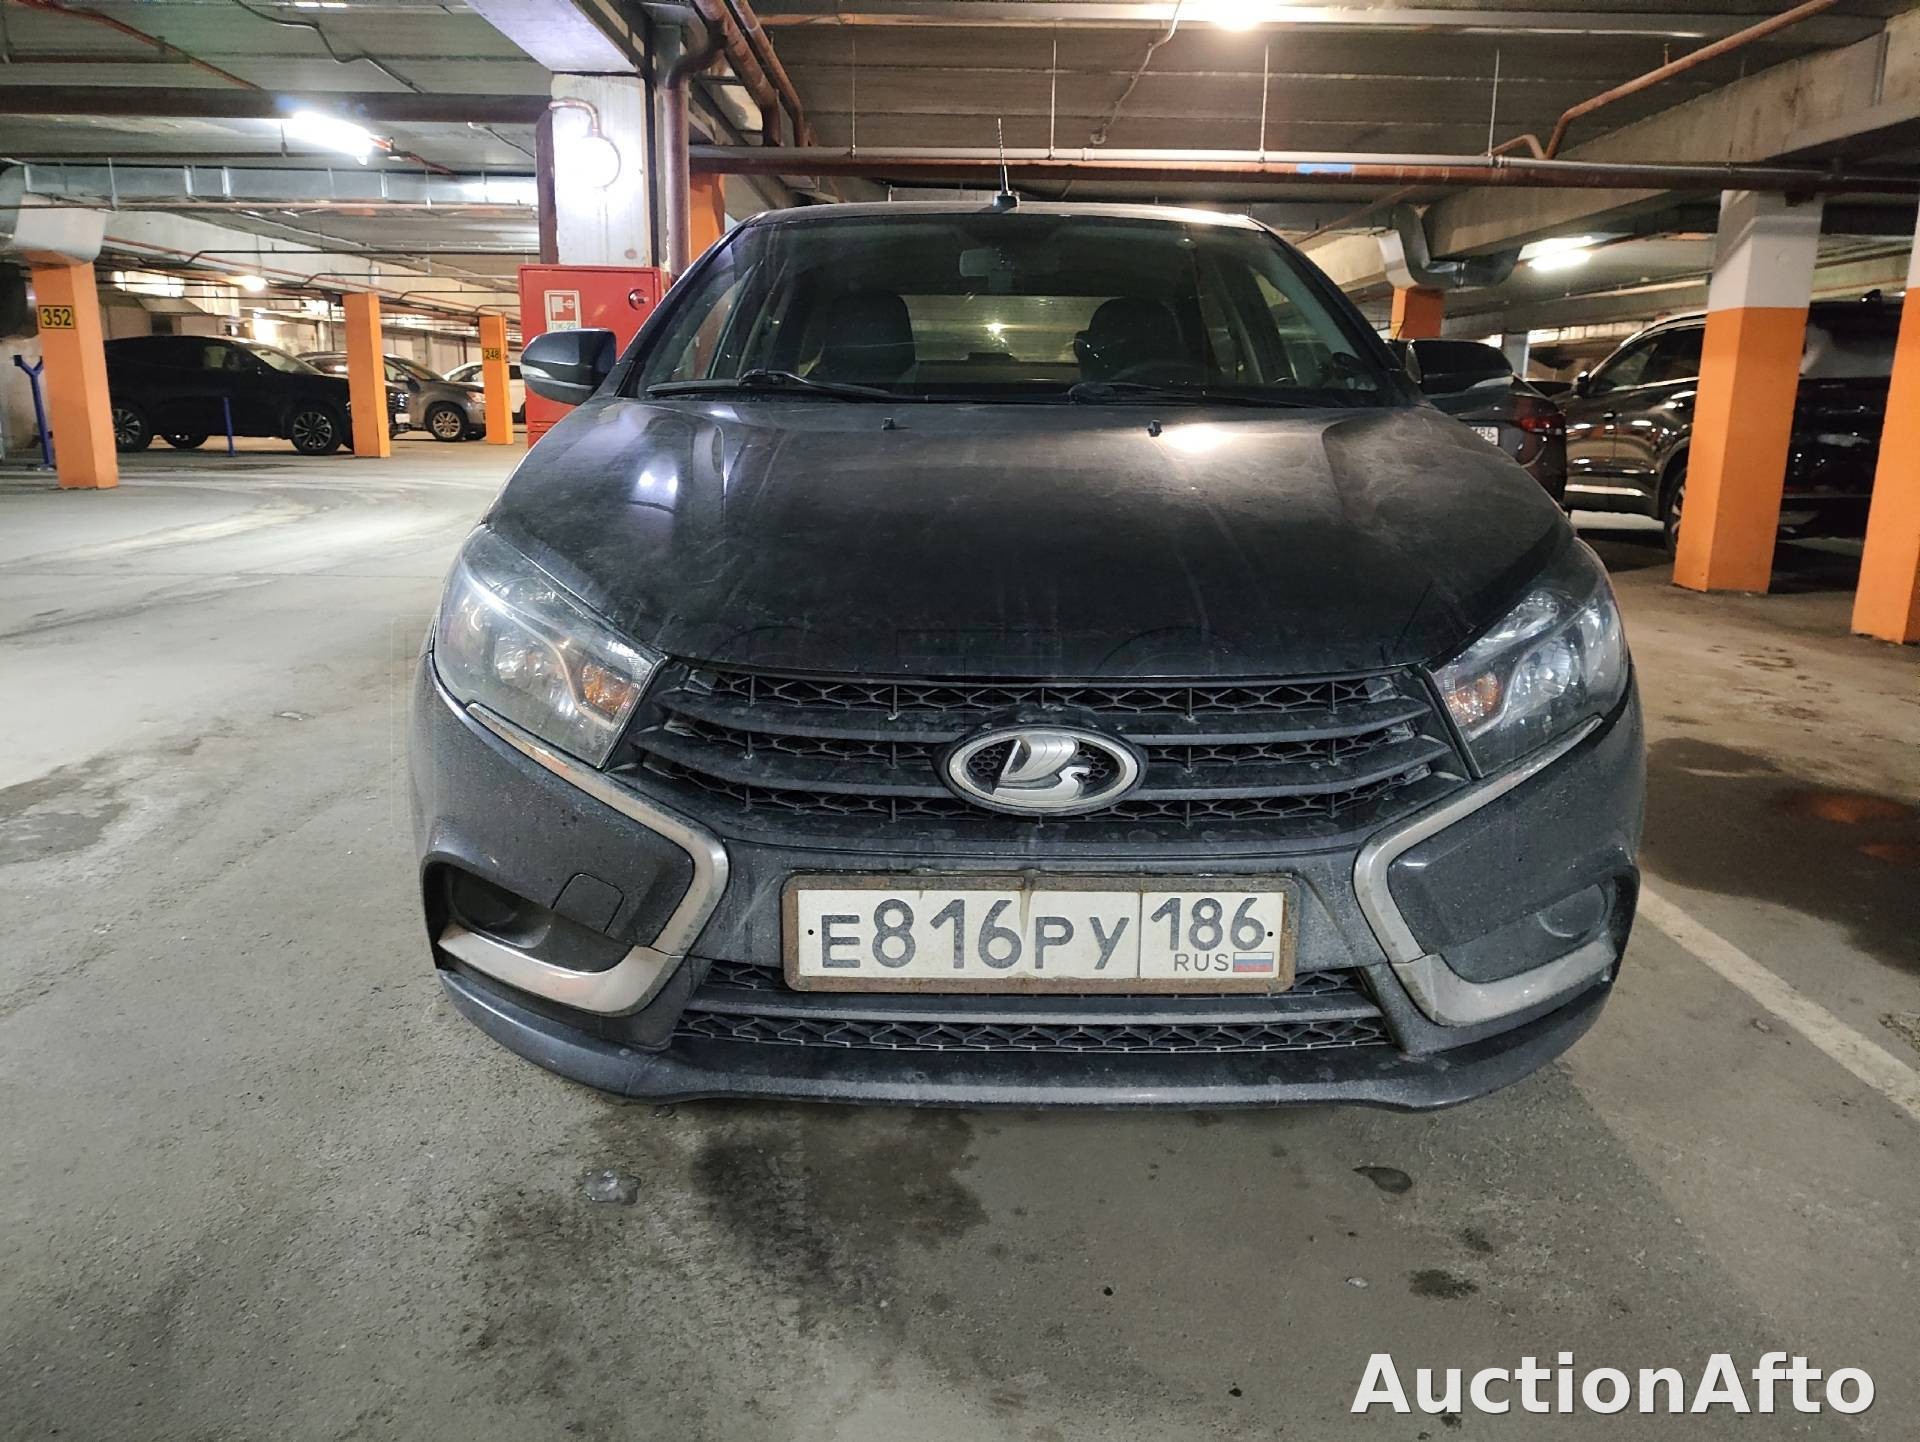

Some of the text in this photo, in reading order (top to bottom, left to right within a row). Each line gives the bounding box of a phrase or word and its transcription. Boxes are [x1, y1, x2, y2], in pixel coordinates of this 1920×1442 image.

[42, 308, 72, 326] 352
[1150, 897, 1266, 951] 186
[1173, 952, 1230, 972] RUS
